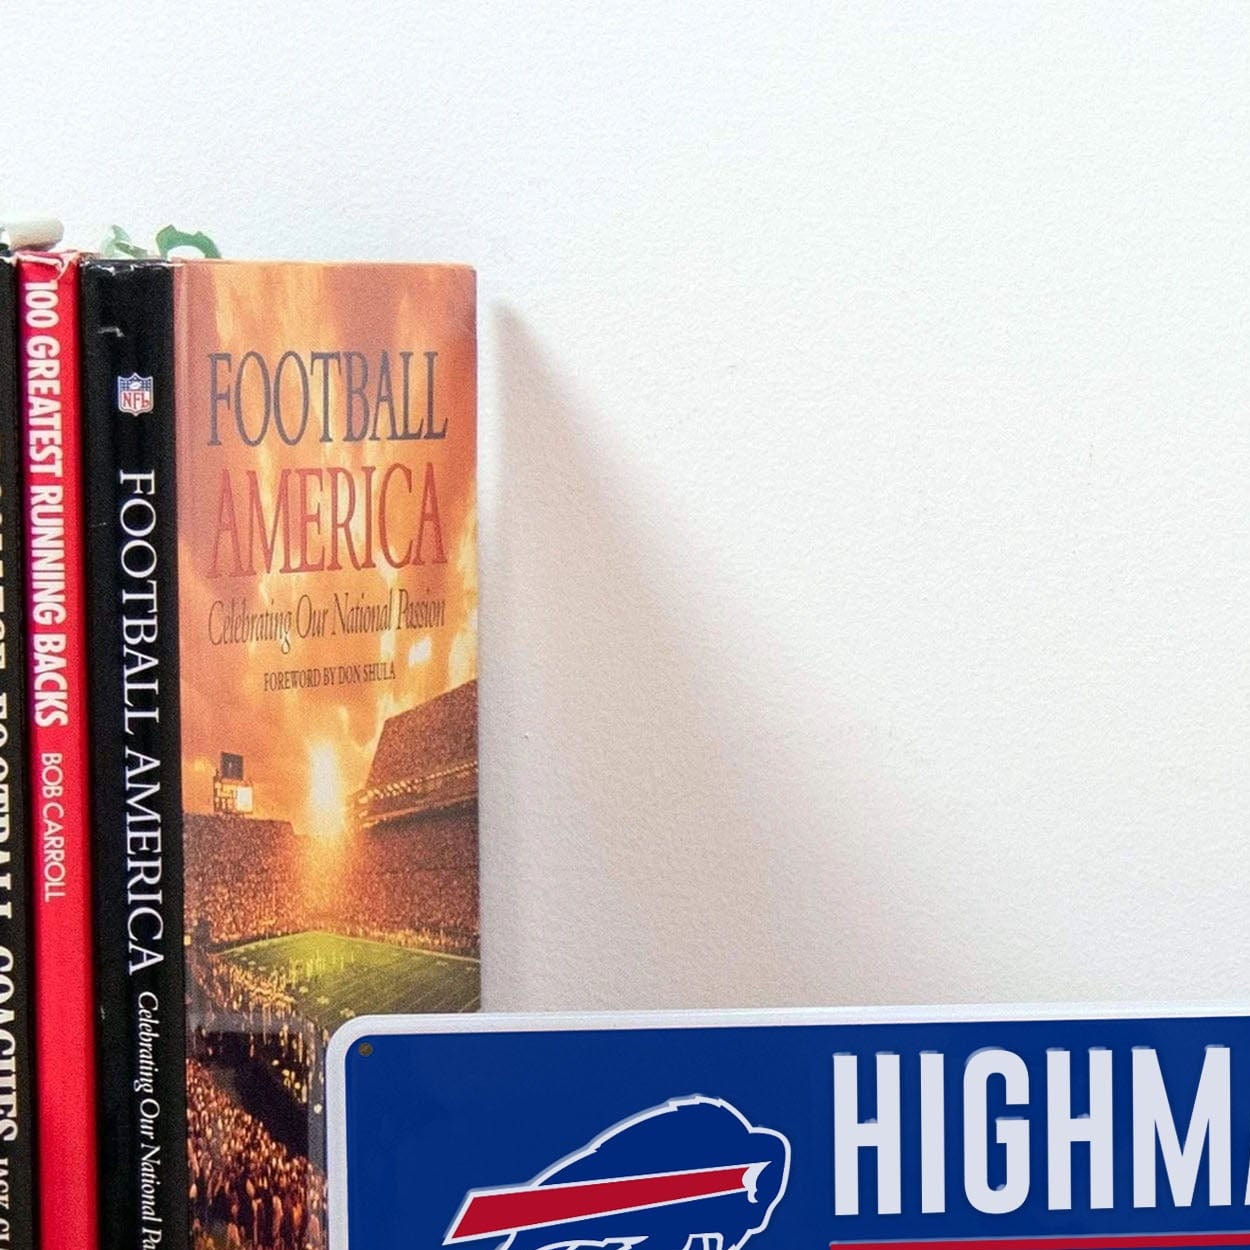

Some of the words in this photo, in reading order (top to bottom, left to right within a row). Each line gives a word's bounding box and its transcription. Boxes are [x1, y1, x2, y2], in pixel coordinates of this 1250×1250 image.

[25, 280, 60, 329] 100
[26, 334, 63, 478] GREATEST
[122, 391, 151, 409] NFL
[207, 350, 448, 447] FOOTBALL
[29, 485, 67, 626] RUNNING
[206, 462, 448, 578] AMERICA
[119, 469, 161, 735] FOOTBALL
[208, 597, 292, 654] Celebrating
[296, 594, 329, 639] Our
[332, 588, 394, 636] National
[396, 588, 446, 631] Passion
[33, 633, 69, 728] BACKS
[263, 666, 321, 692] FOREWORD
[323, 666, 336, 686] BY
[338, 664, 361, 684] DON
[363, 661, 396, 682] SHULA
[41, 752, 64, 799] BOB
[42, 802, 66, 903] CARROLL
[125, 747, 164, 976] AMERICA
[133, 991, 160, 1094] Celebrating
[139, 1098, 160, 1140] Our
[140, 1142, 163, 1223] National
